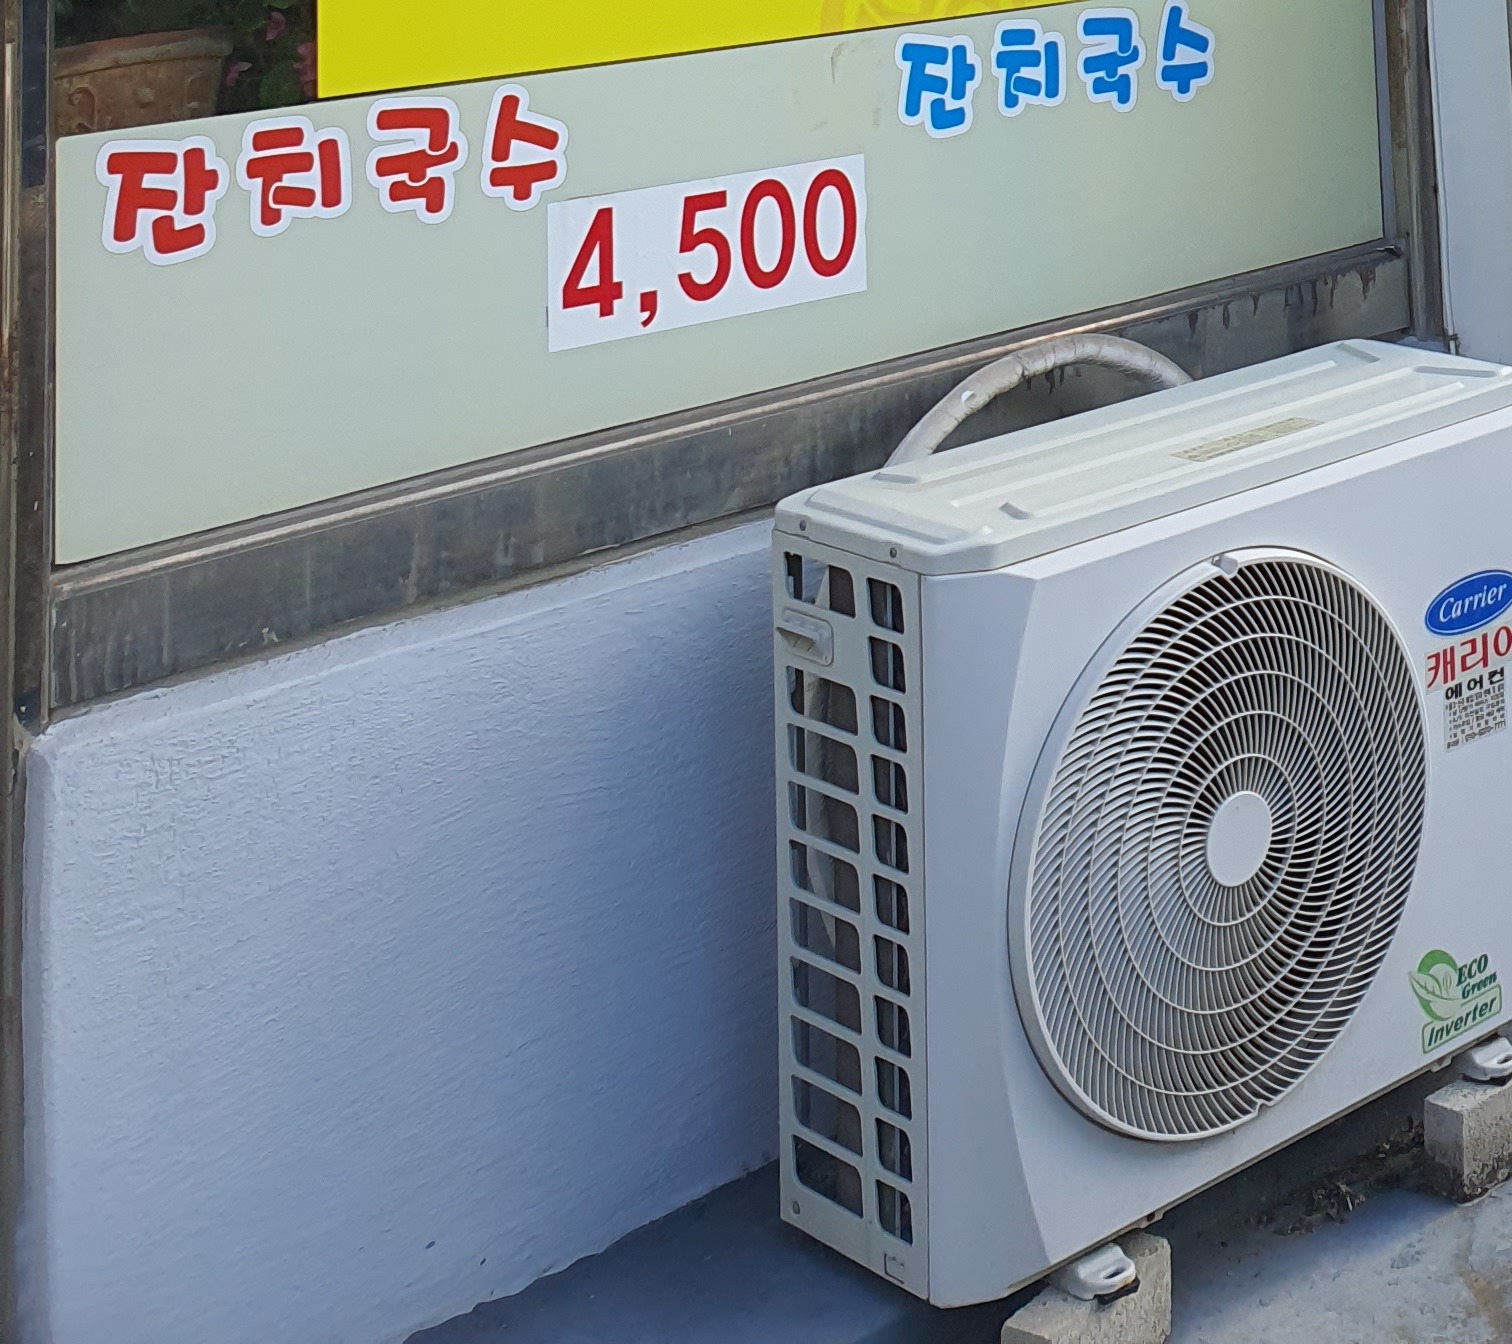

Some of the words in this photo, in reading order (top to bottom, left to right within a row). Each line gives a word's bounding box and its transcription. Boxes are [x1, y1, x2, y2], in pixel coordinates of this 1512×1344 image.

[901, 4, 1212, 132] 잔치국수
[102, 92, 560, 256] 잔치국수
[561, 168, 859, 329] 4,500
[1438, 582, 1509, 623] Carrier
[1456, 953, 1489, 988] ECO
[1461, 971, 1498, 1001] Green
[1427, 996, 1497, 1048] Inverter
